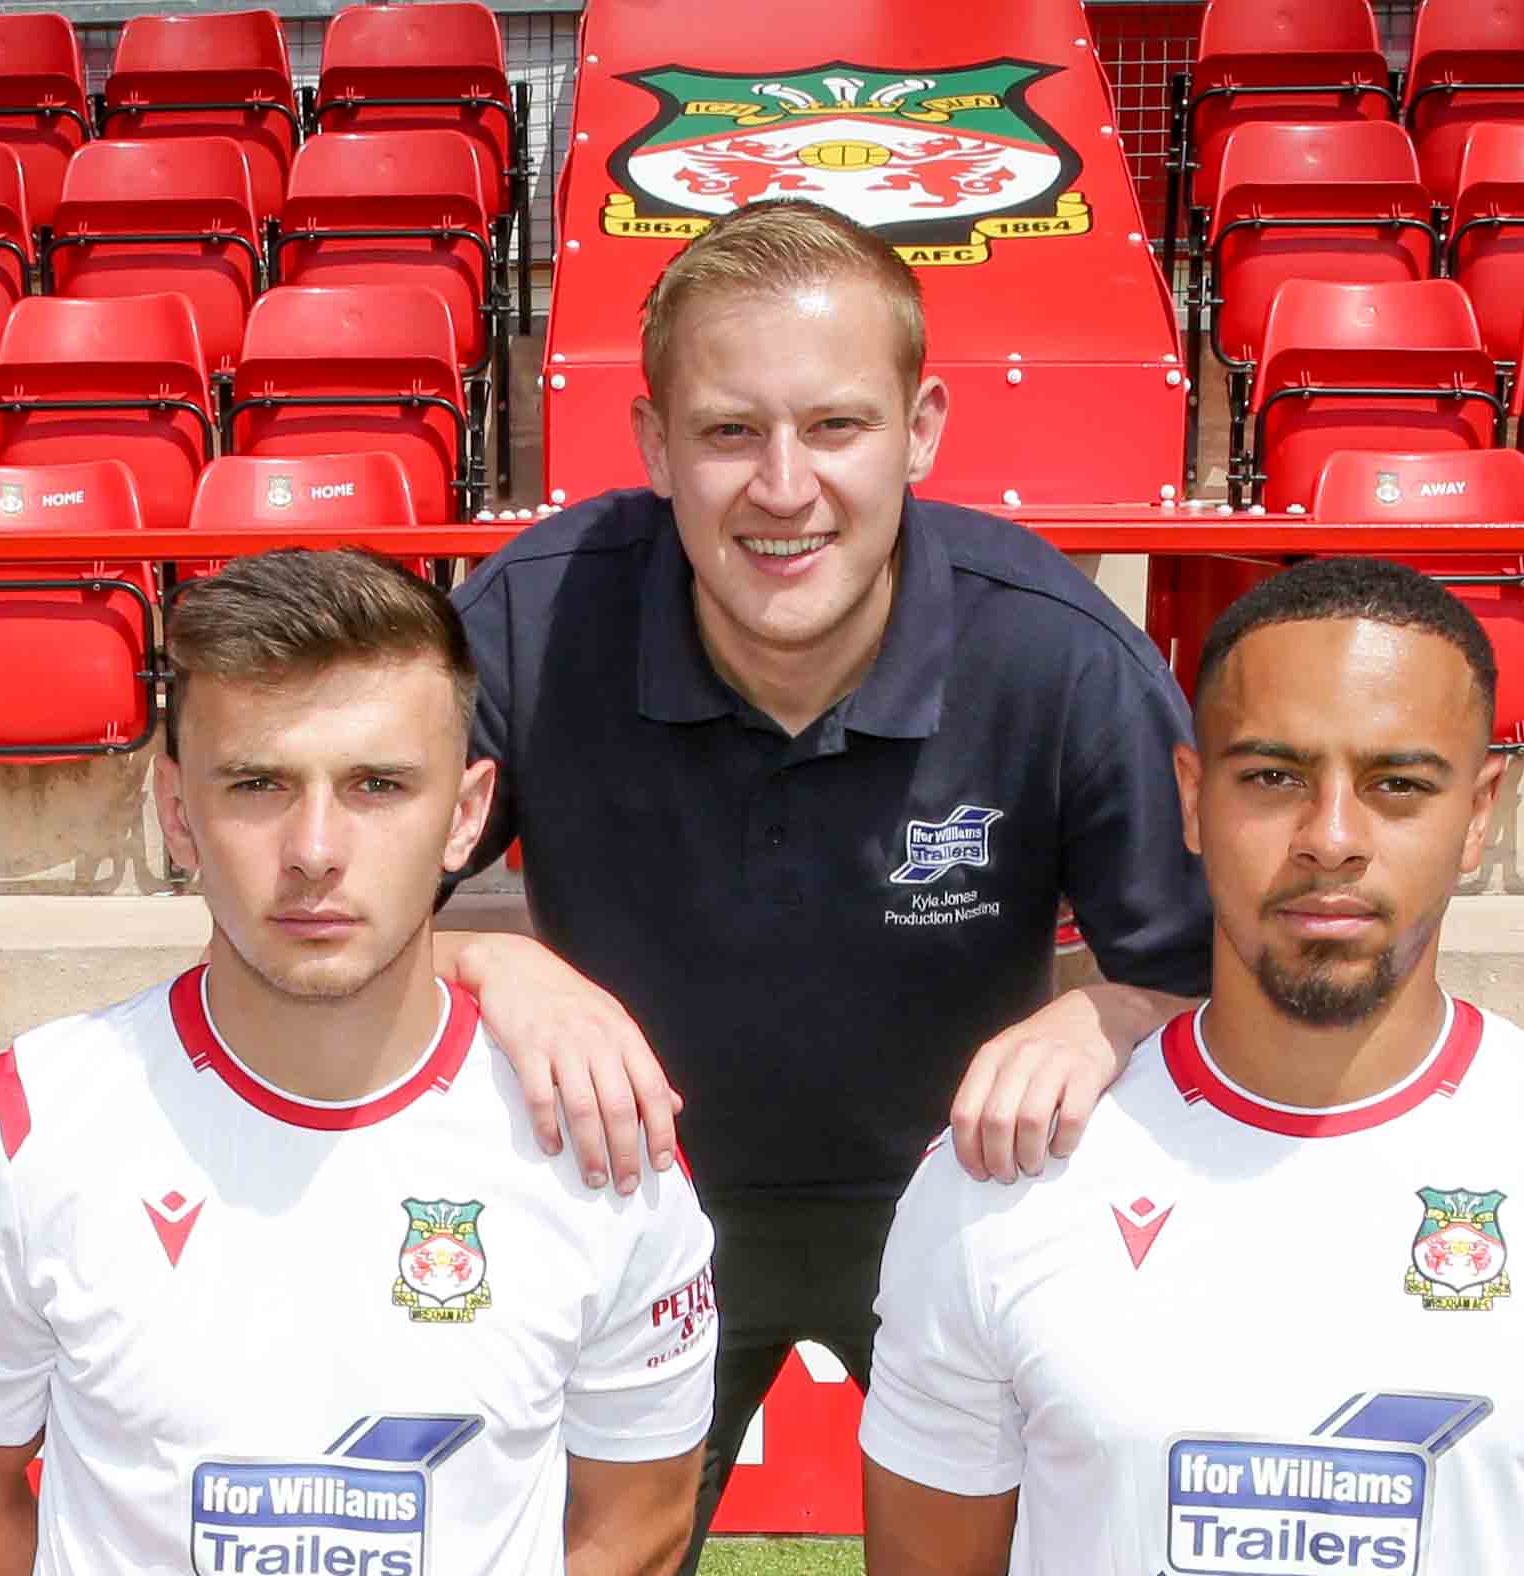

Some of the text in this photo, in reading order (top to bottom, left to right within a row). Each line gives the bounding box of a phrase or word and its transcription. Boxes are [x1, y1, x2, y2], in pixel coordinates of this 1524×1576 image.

[621, 221, 692, 234] 1864
[995, 220, 1071, 233] 1864
[908, 249, 975, 262] AFC
[311, 482, 355, 500] HOME
[1420, 480, 1467, 497] AWAY
[41, 490, 85, 508] HOME
[912, 826, 983, 844] Ifor Williams
[913, 846, 981, 862] Trailers
[940, 889, 978, 908] Jones
[884, 910, 953, 926] Production
[1180, 1453, 1414, 1506] Ifor Williams
[202, 1475, 417, 1522] Ifor Williams
[1179, 1514, 1407, 1570] Trailers
